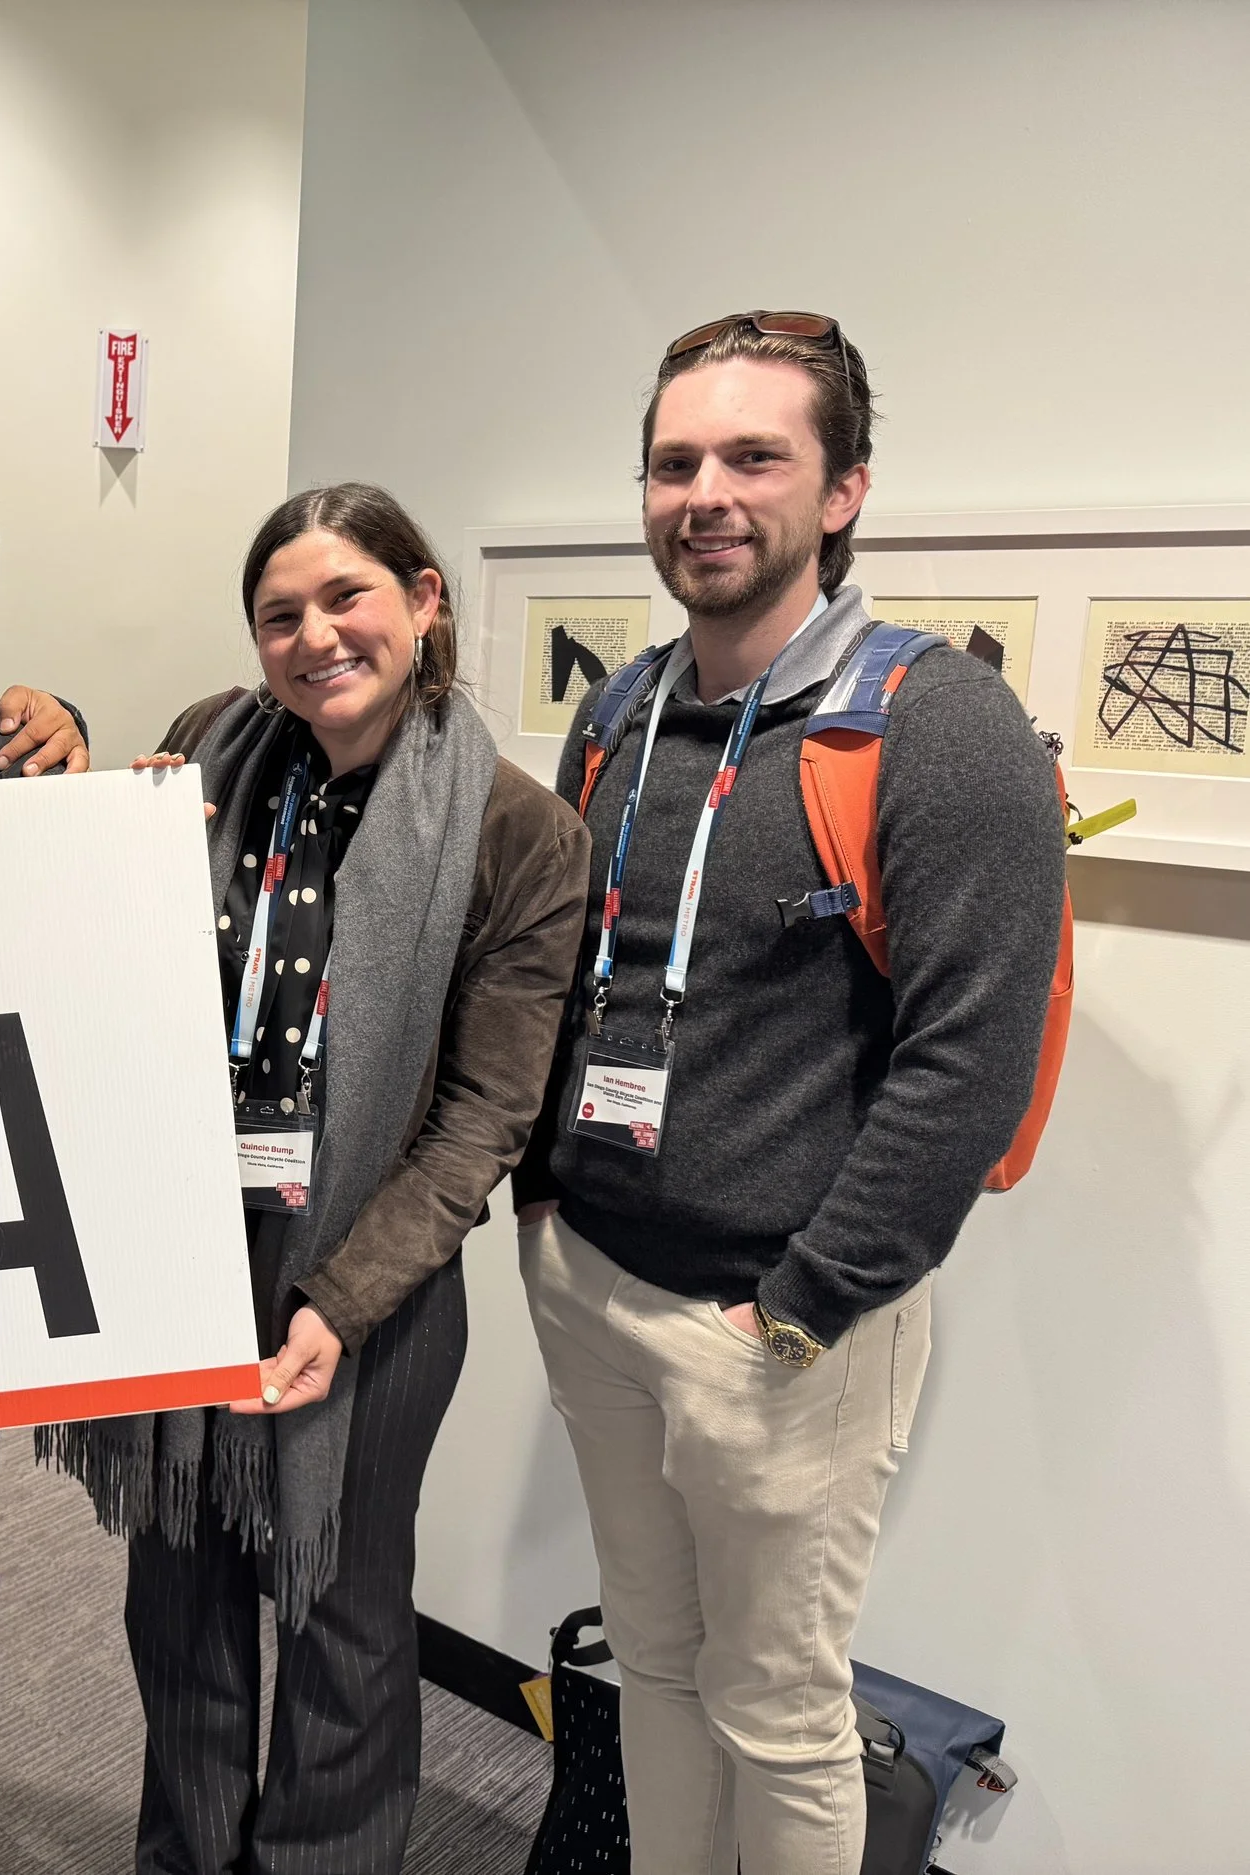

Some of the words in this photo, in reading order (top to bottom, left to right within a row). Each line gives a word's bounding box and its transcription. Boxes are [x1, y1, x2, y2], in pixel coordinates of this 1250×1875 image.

[111, 341, 134, 356] FIRE
[687, 870, 699, 901] STRAVA
[680, 907, 691, 937] METRO
[251, 948, 262, 975] STRAVA
[245, 981, 256, 1008] METRO
[603, 1076, 614, 1084] Ian
[615, 1079, 646, 1092] Hembree
[240, 1143, 269, 1152] Quincie
[271, 1146, 294, 1155] Bump
